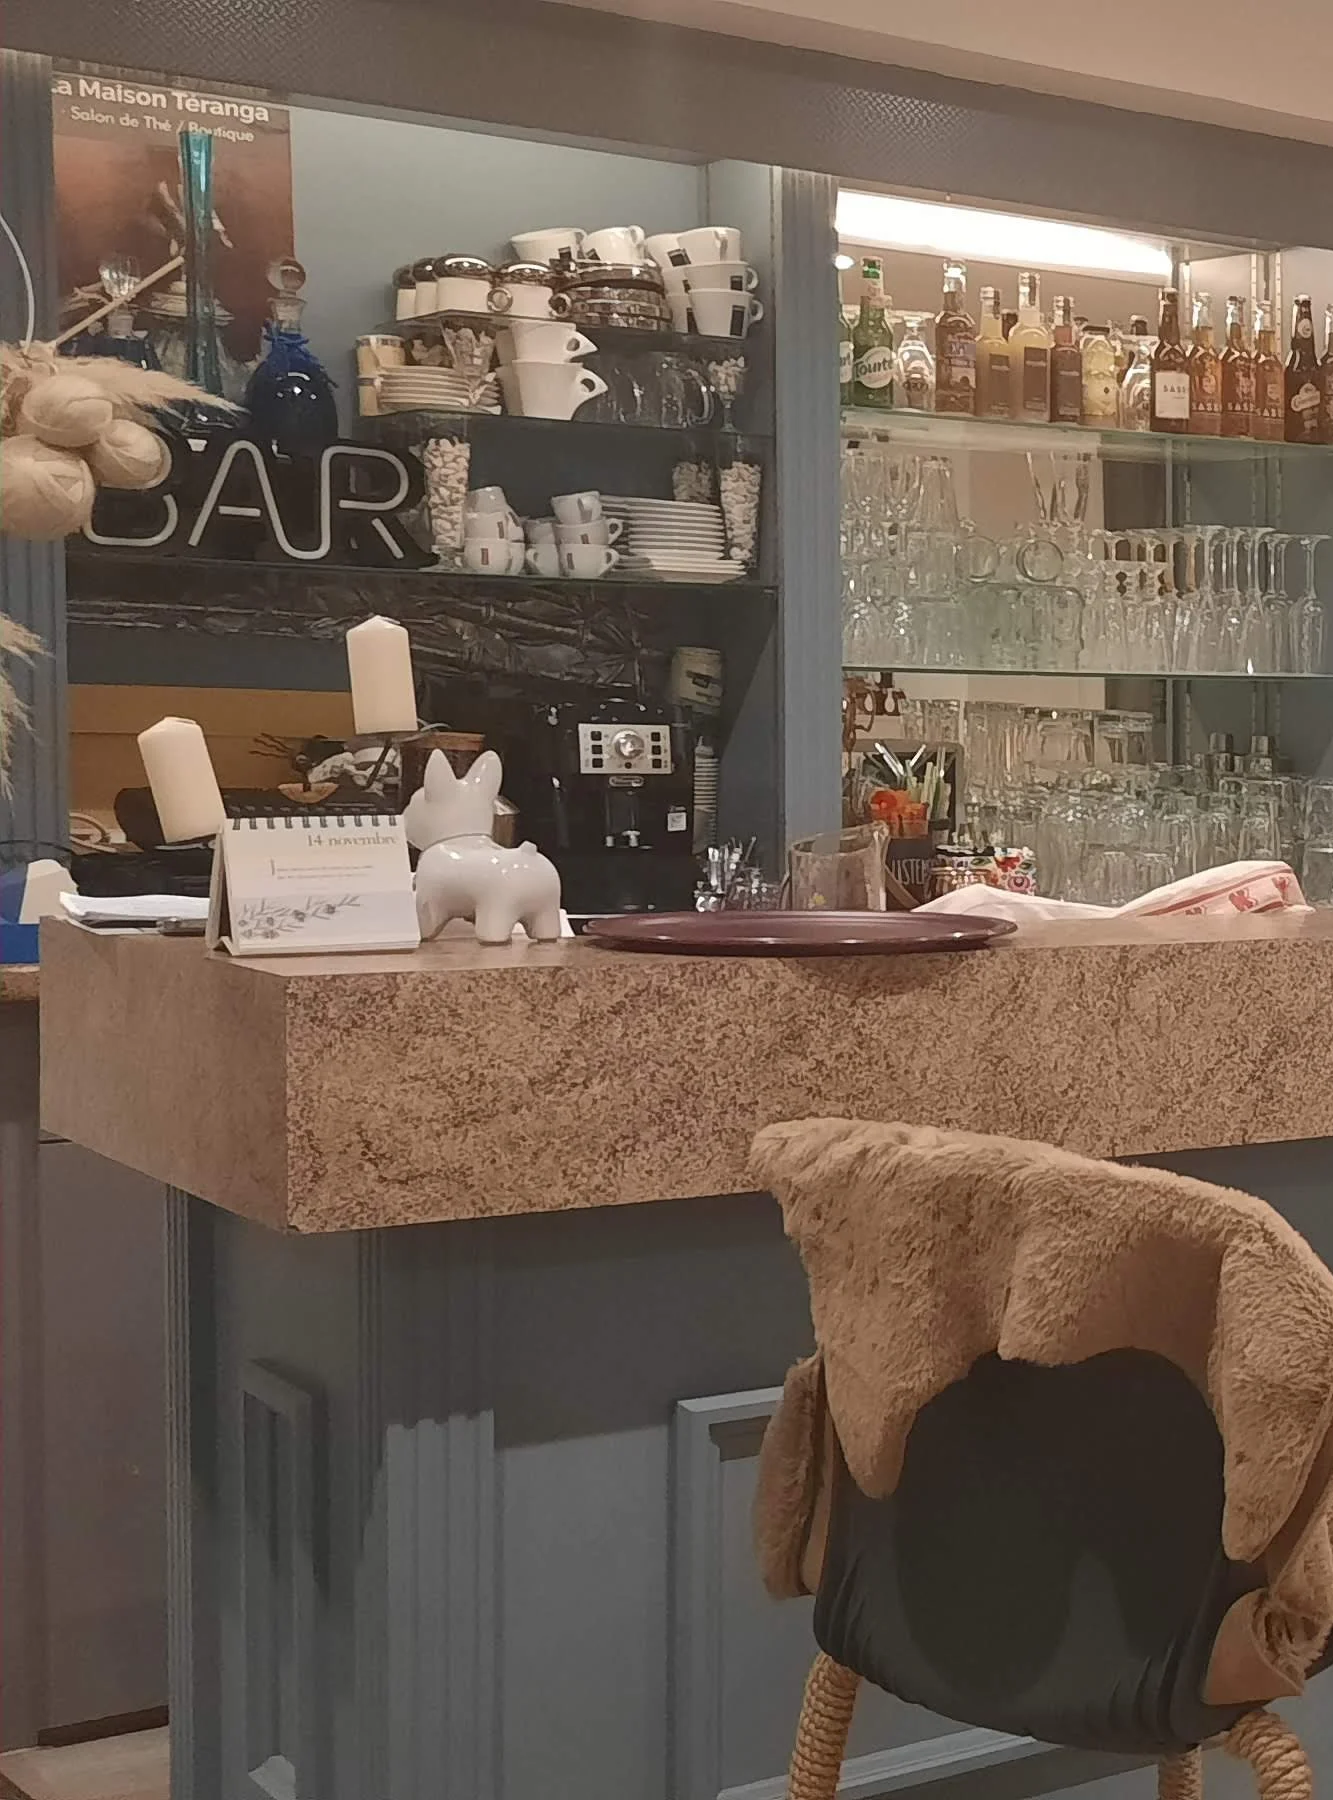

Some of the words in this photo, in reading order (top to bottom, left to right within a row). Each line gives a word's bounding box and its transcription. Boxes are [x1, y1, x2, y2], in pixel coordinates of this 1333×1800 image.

[79, 78, 167, 110] Maison
[171, 91, 270, 124] Téranga
[70, 105, 115, 125] Salon
[119, 112, 140, 128] de
[143, 114, 172, 132] Thé
[307, 834, 323, 847] 14
[328, 832, 397, 847] novembre
